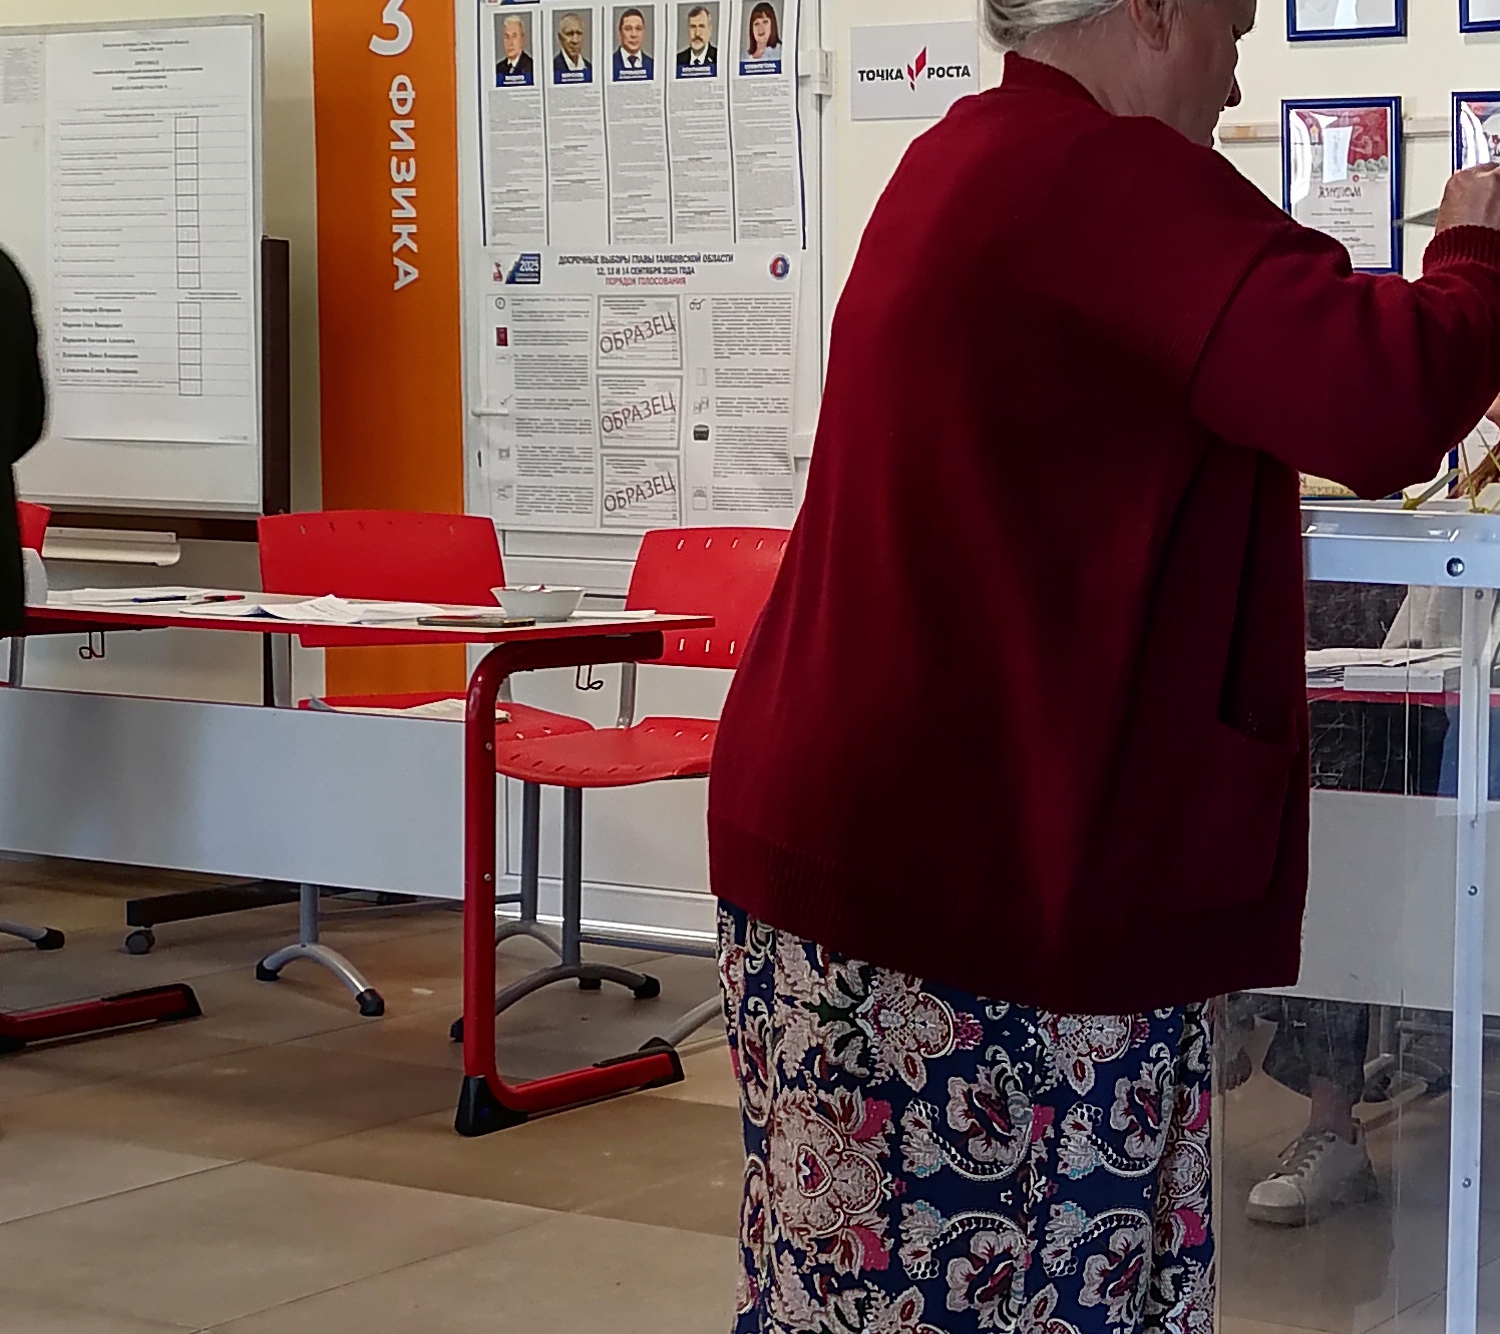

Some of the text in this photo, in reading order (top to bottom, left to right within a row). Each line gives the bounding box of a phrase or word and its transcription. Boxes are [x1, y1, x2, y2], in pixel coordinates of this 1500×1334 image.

[858, 68, 904, 82] ТОЧКА
[927, 65, 971, 79] РОСТА
[389, 74, 419, 291] ФИЗИКА
[703, 254, 734, 263] ОБЛАСТИ
[600, 312, 677, 354] ОБРАЗЕЦ
[601, 392, 676, 434] ОБРАЗЕЦ
[604, 472, 676, 513] ОБРАЗЕЦ
